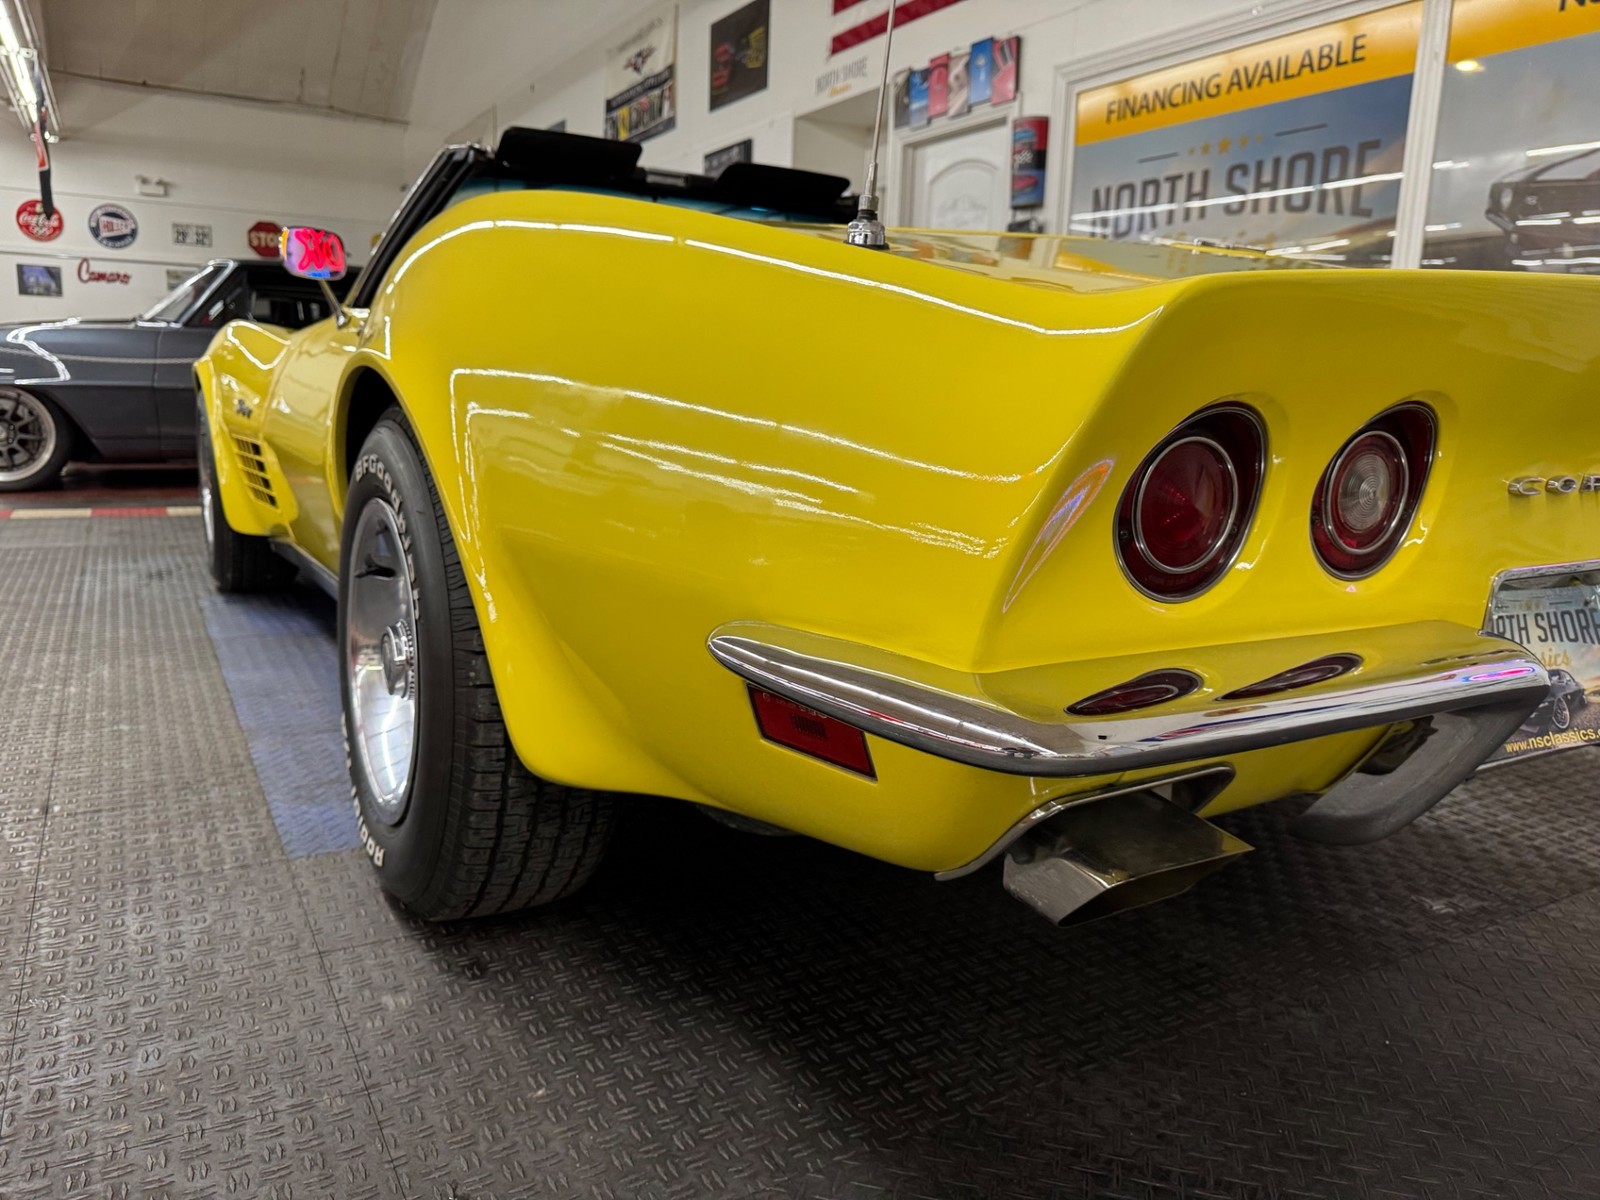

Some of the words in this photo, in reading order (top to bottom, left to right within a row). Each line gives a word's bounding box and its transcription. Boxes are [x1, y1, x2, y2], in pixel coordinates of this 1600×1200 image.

[1106, 73, 1222, 124] FINANCING
[1226, 34, 1367, 95] AVAILABLE
[1090, 168, 1210, 239] NORTH
[1223, 139, 1381, 219] SHORE
[250, 231, 280, 248] STO
[77, 258, 132, 285] Camaro
[1541, 647, 1572, 668] sics
[1504, 727, 1600, 753] www.nsclassics.
